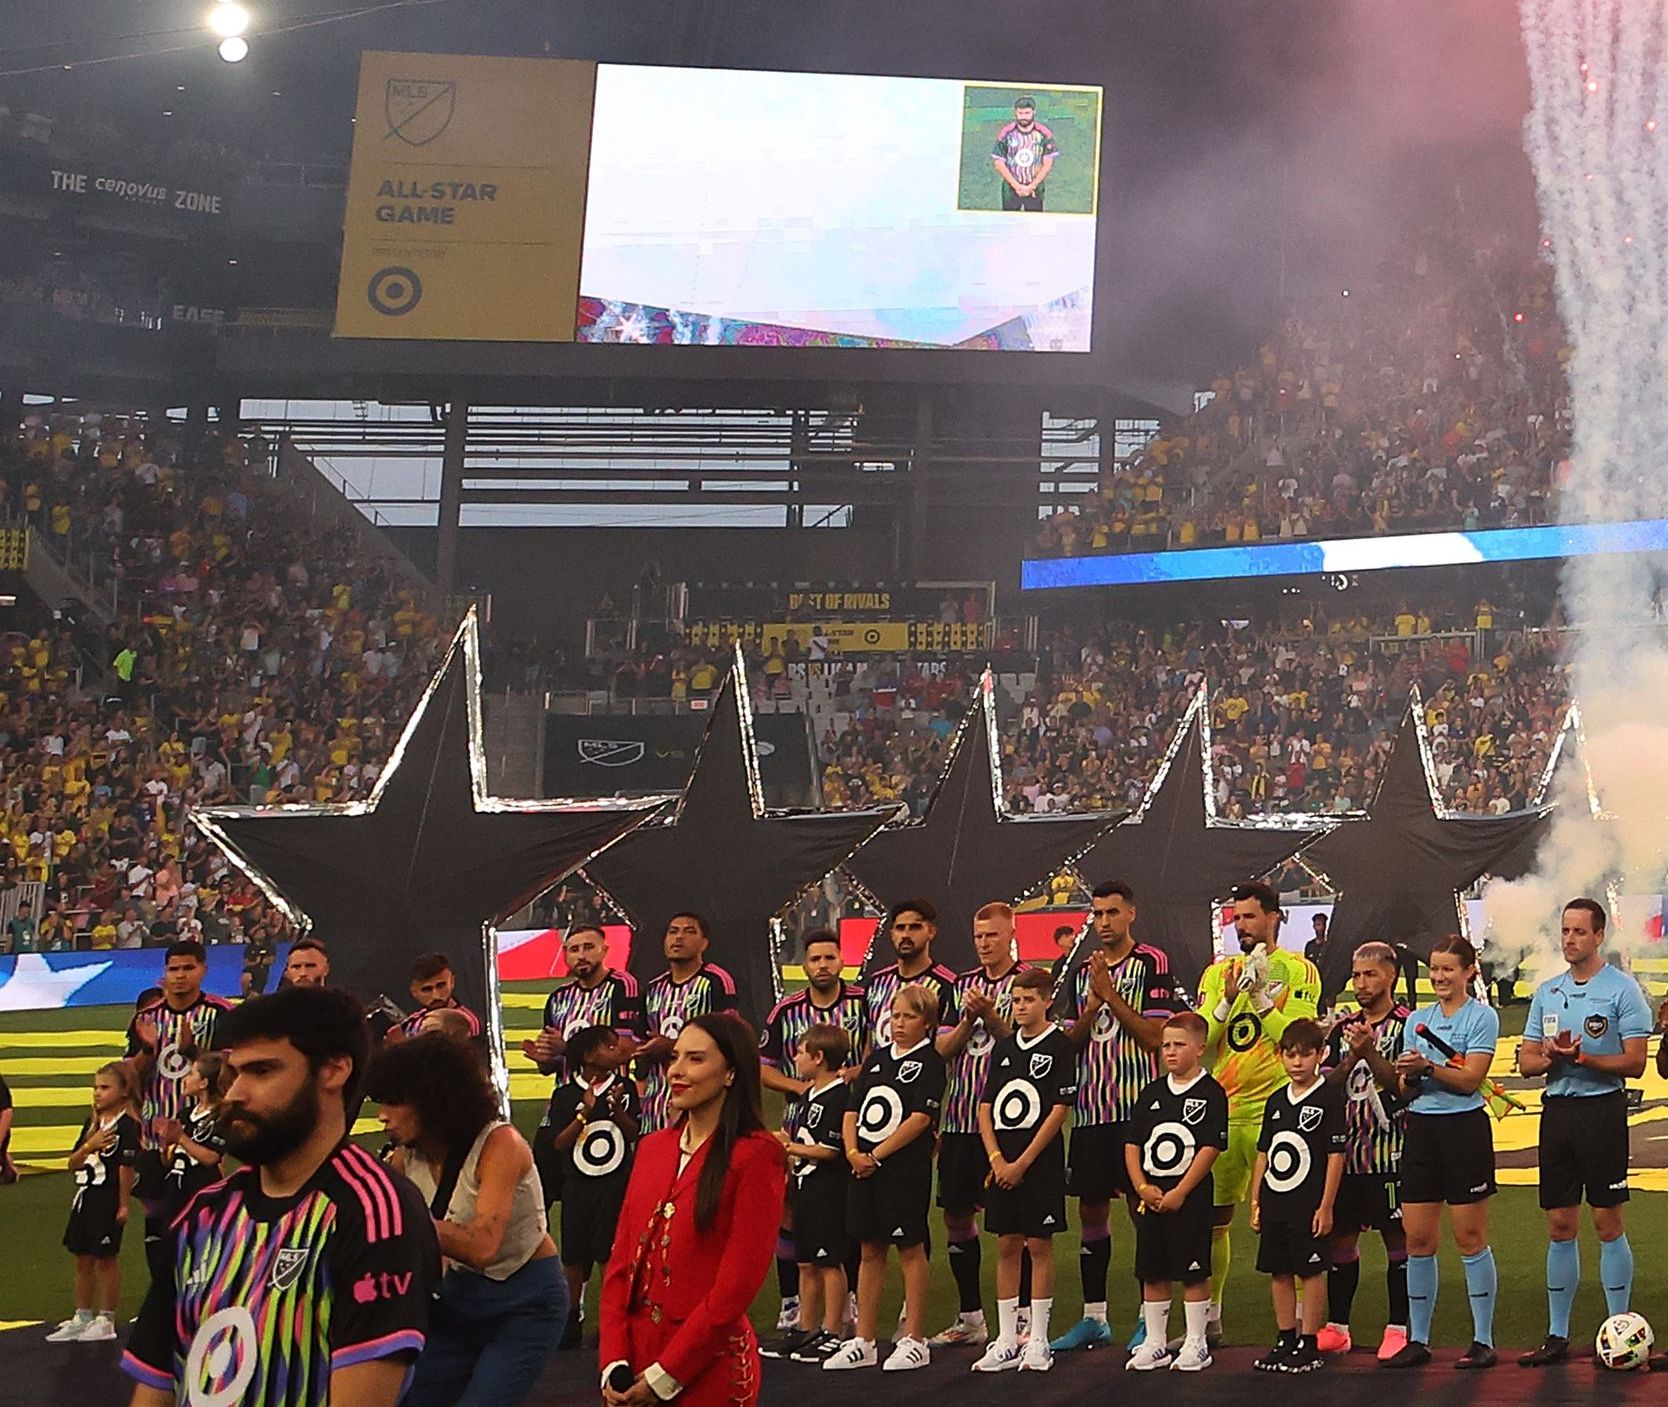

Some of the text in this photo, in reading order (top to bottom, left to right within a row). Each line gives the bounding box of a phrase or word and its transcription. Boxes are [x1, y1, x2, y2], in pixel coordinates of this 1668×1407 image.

[51, 170, 87, 193] THE
[175, 191, 222, 214] ZONE
[377, 180, 497, 201] ALL-STAR
[376, 205, 455, 225] GAME
[825, 594, 842, 609] OF
[844, 593, 890, 610] RIVALS
[380, 1272, 412, 1298] tv
